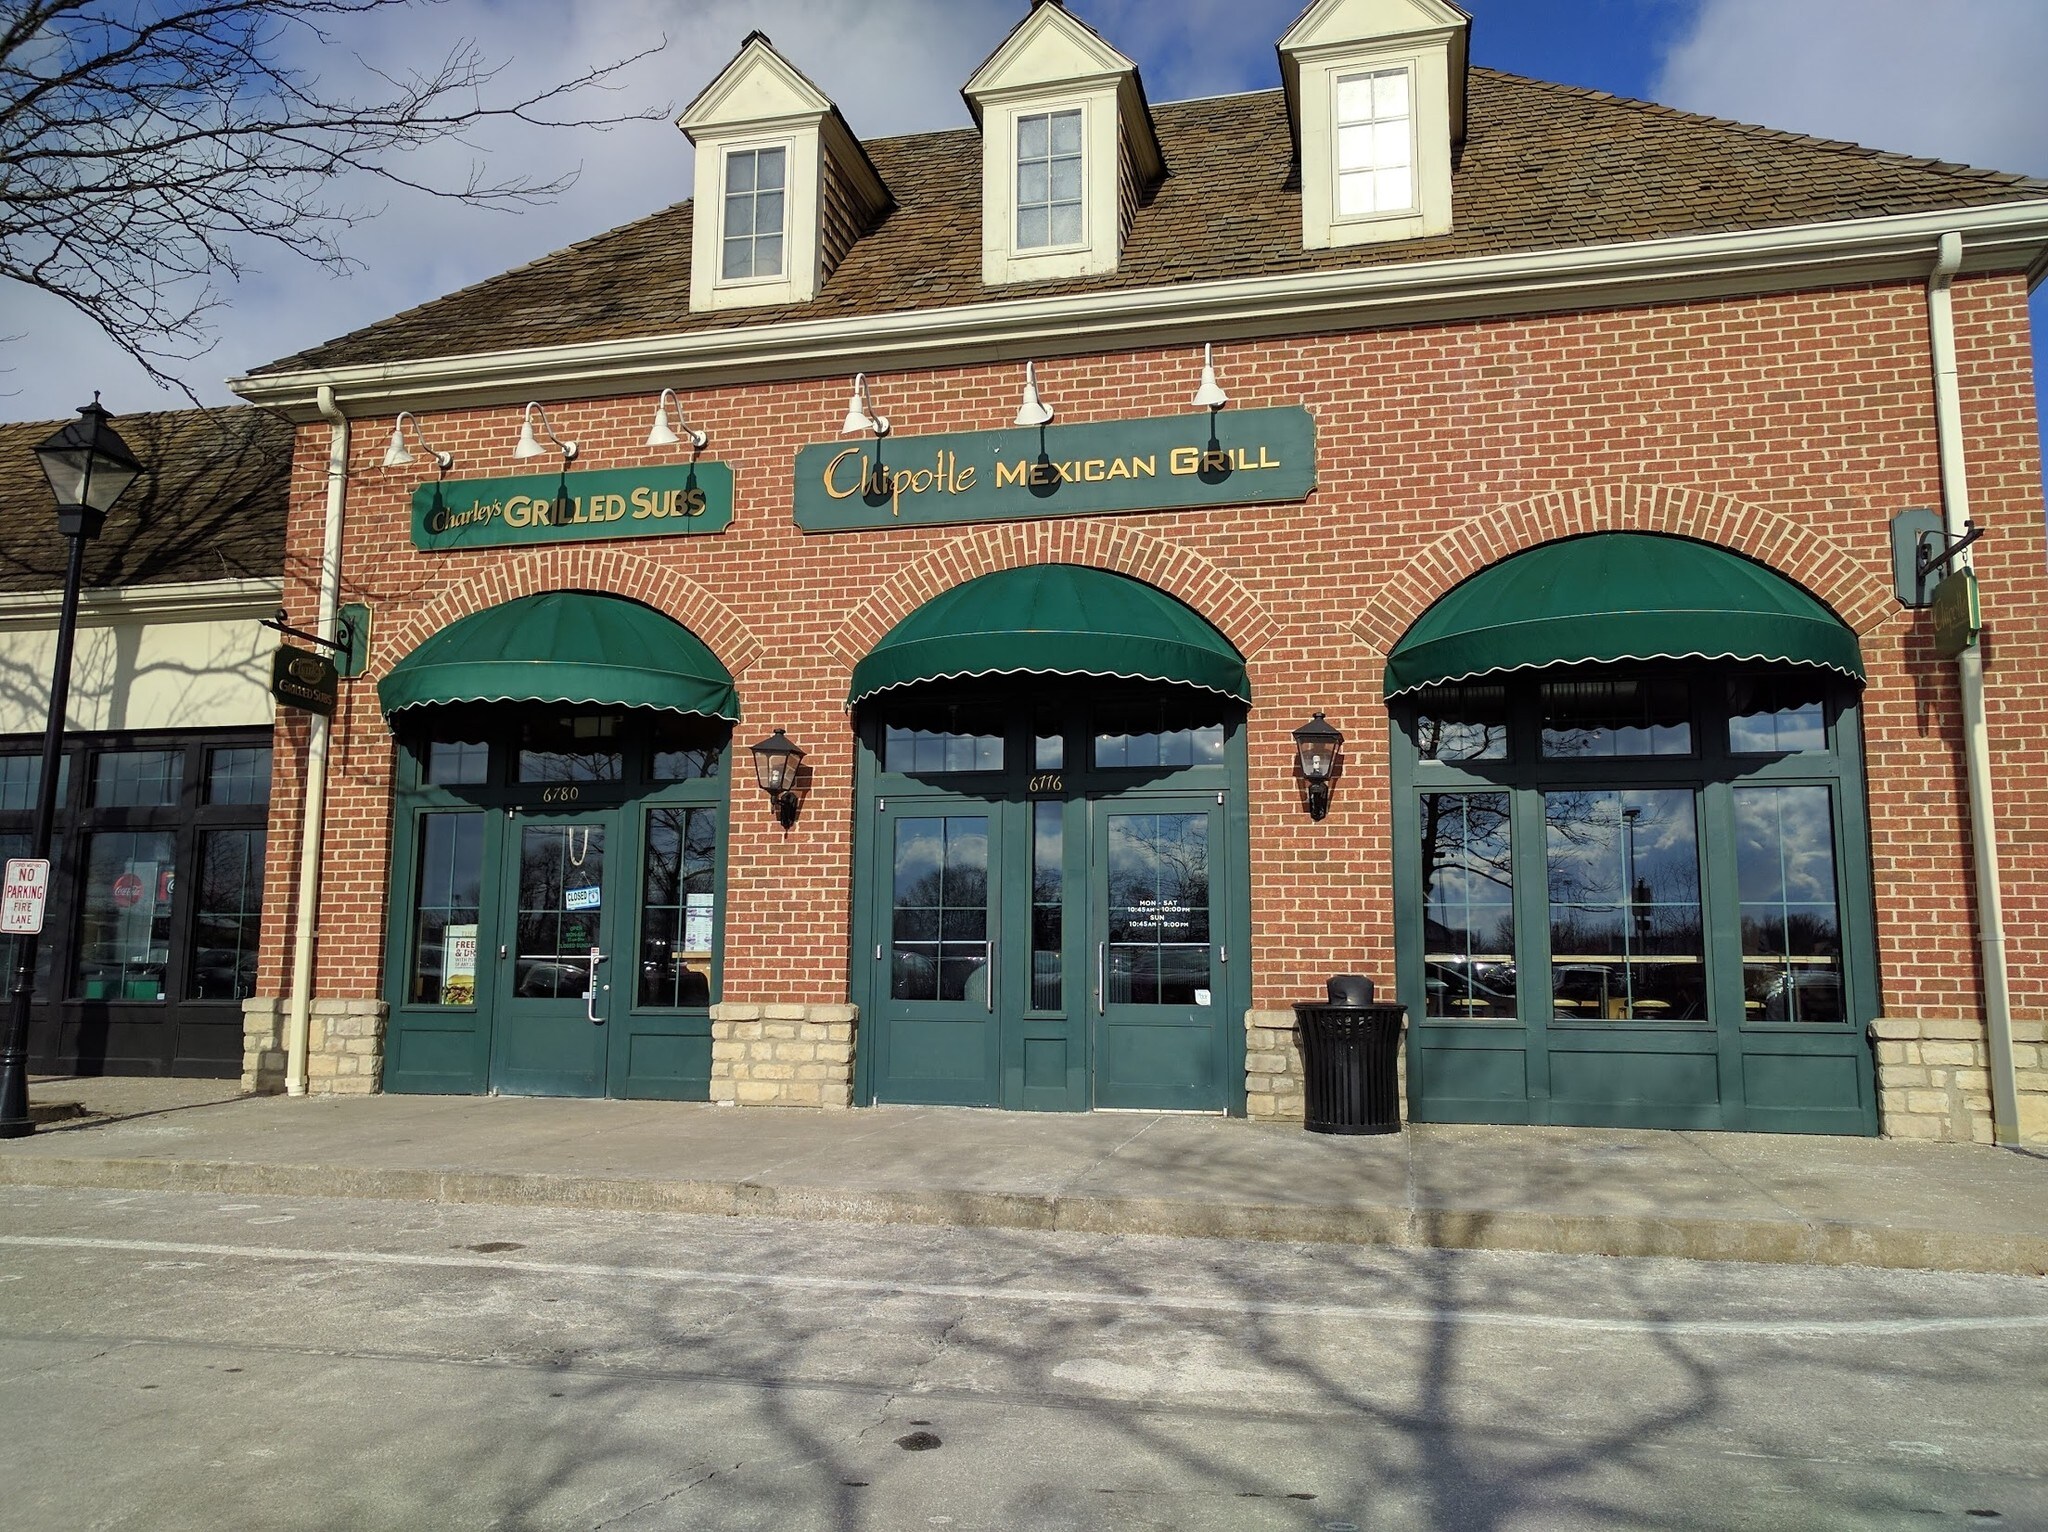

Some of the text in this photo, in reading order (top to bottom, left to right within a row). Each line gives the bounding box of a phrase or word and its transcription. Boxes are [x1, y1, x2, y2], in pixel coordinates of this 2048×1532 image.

[823, 445, 1281, 517] Chipotle MEXICAN GRILL
[431, 486, 707, 532] Charley's GRILLED SUBS
[1029, 774, 1062, 792] 6776
[543, 786, 579, 803] 6780
[19, 868, 35, 881] NO
[7, 885, 43, 899] PARKING
[567, 890, 587, 902] CLOSED
[14, 902, 32, 912] FIRE
[11, 915, 32, 924] LANE
[455, 940, 476, 949] FREE
[455, 949, 462, 957] &
